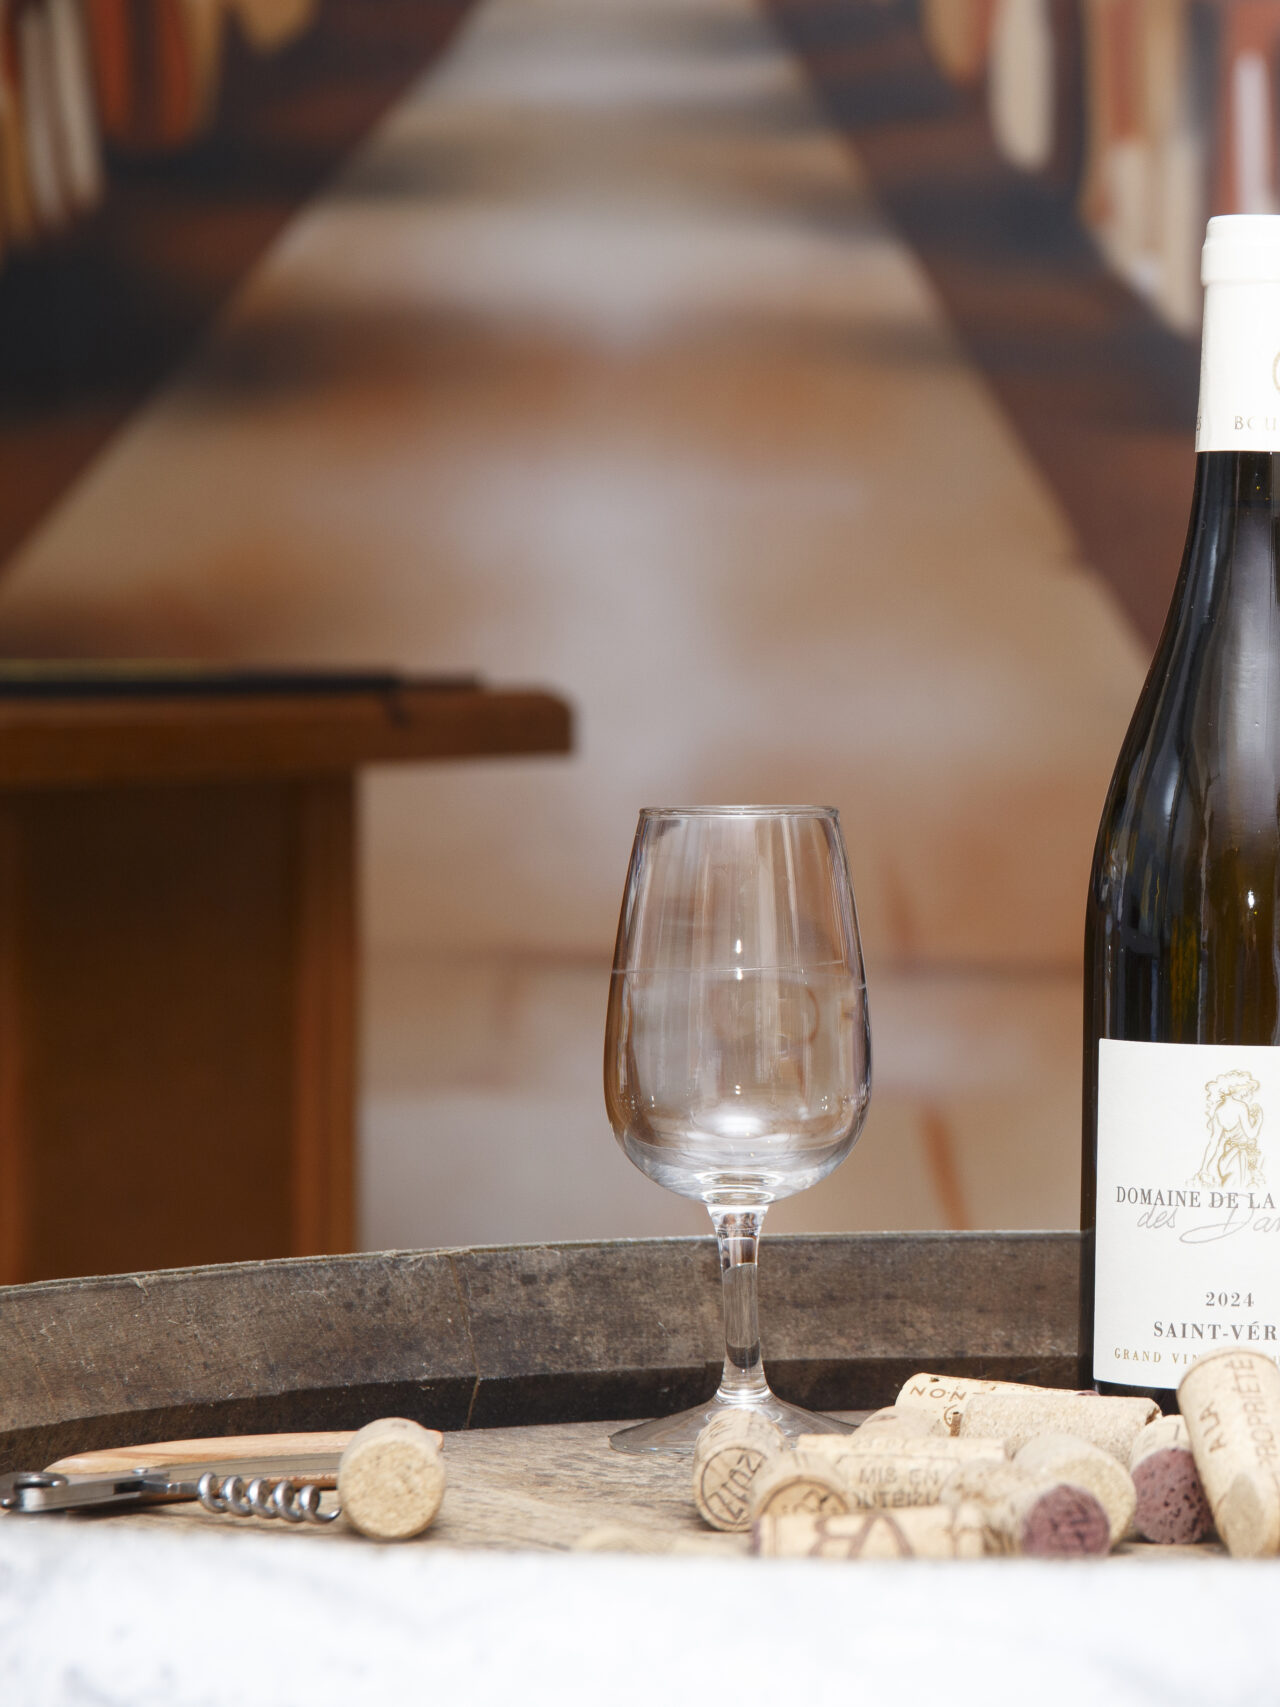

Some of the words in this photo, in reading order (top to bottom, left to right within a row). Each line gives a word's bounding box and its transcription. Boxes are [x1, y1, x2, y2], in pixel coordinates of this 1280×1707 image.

[1116, 1186, 1201, 1208] DOMAINE
[1208, 1191, 1239, 1209] DE
[1249, 1192, 1275, 1209] LA
[1136, 1203, 1177, 1230] des
[1205, 1291, 1254, 1307] 2024
[1114, 1347, 1162, 1363] GRAND
[909, 1386, 967, 1401] NON
